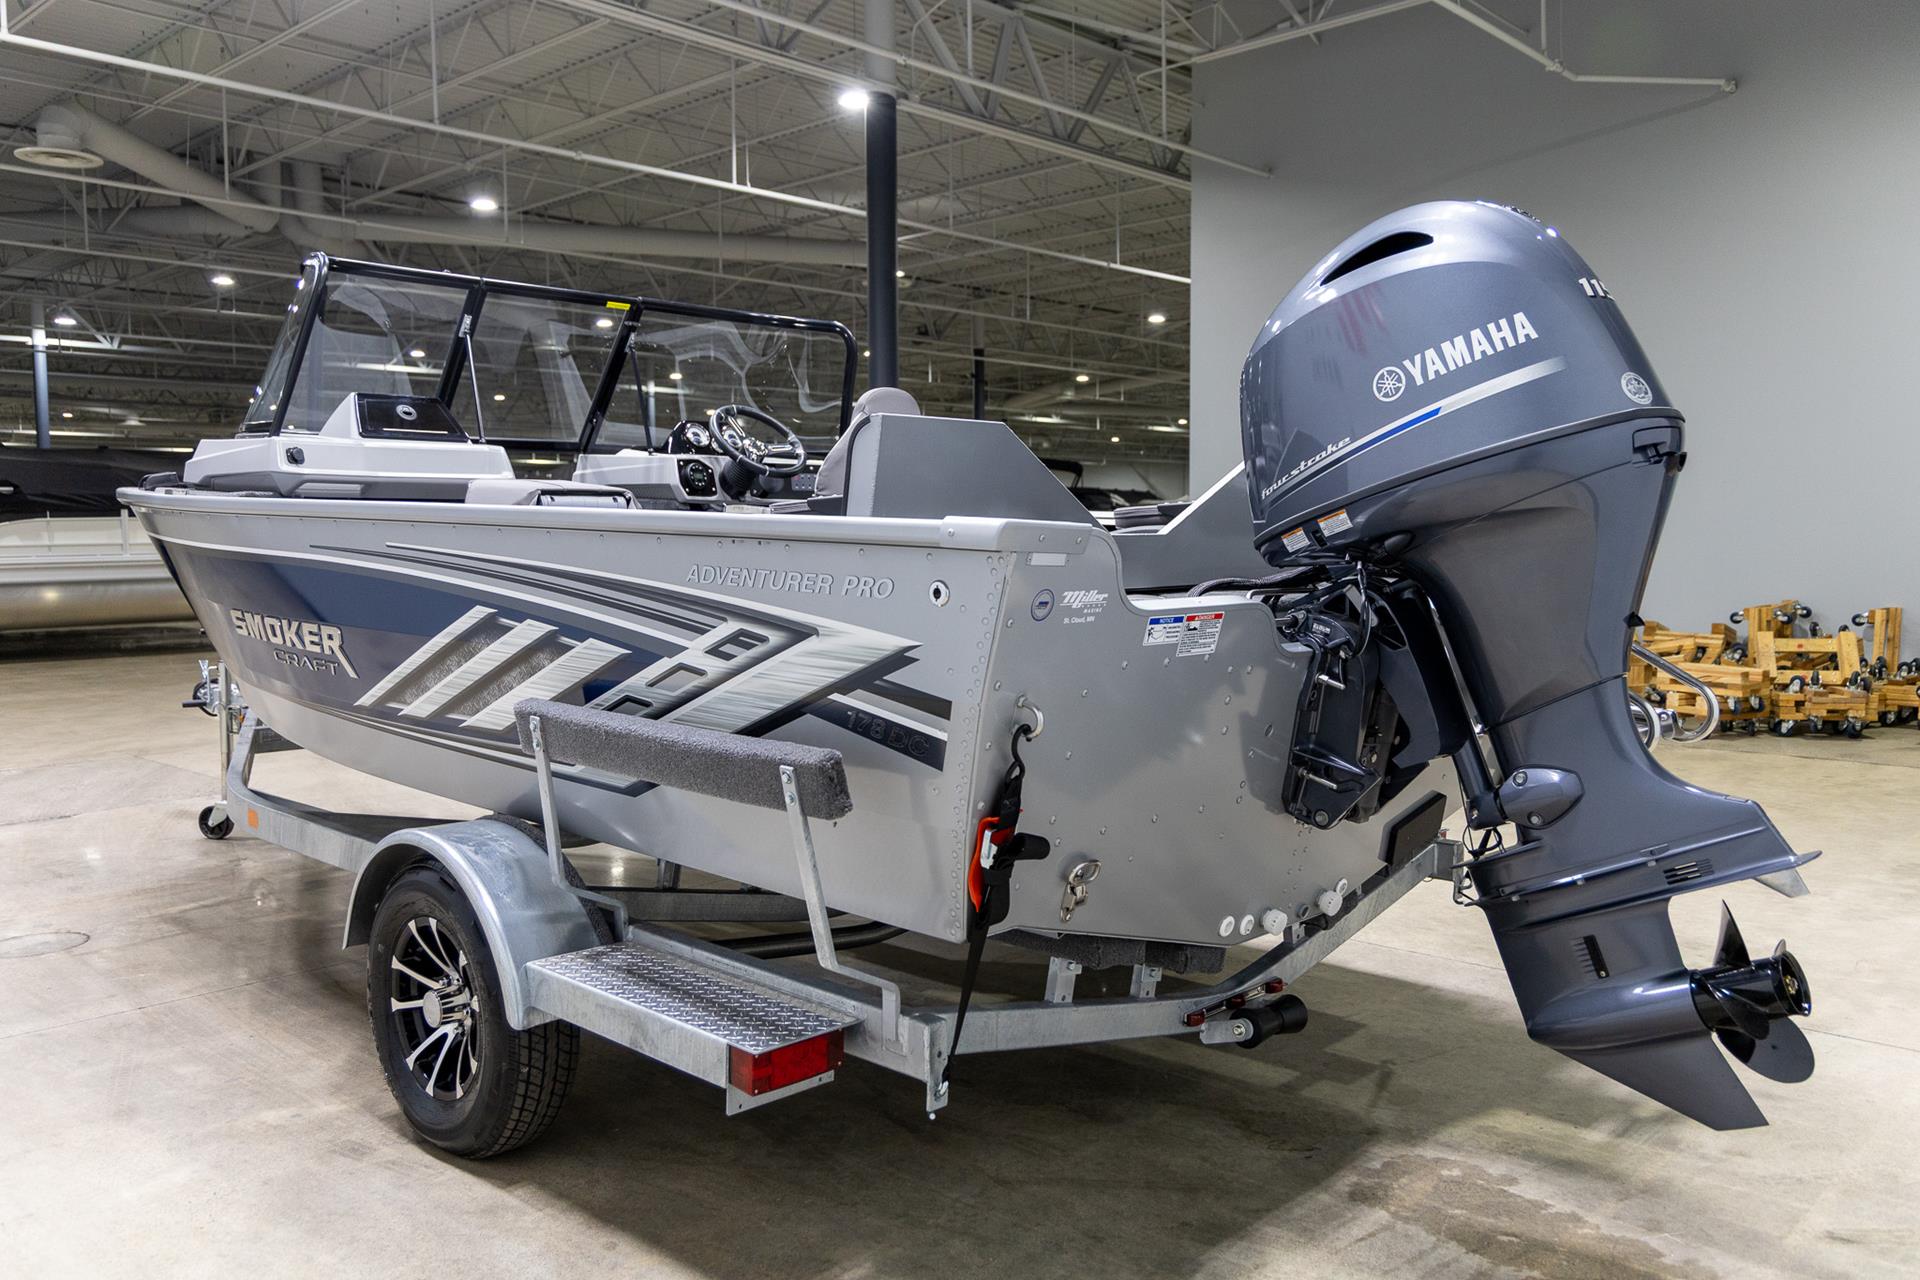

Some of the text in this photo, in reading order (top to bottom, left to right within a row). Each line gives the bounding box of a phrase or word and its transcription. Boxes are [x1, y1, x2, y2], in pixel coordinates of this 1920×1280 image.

[1402, 311, 1539, 386] YAMAHA
[687, 563, 895, 599] ADVENTURER PRO
[1062, 590, 1108, 608] Miller
[230, 608, 360, 679] SMOKER
[273, 648, 340, 676] CRAFT
[847, 710, 887, 739] 178
